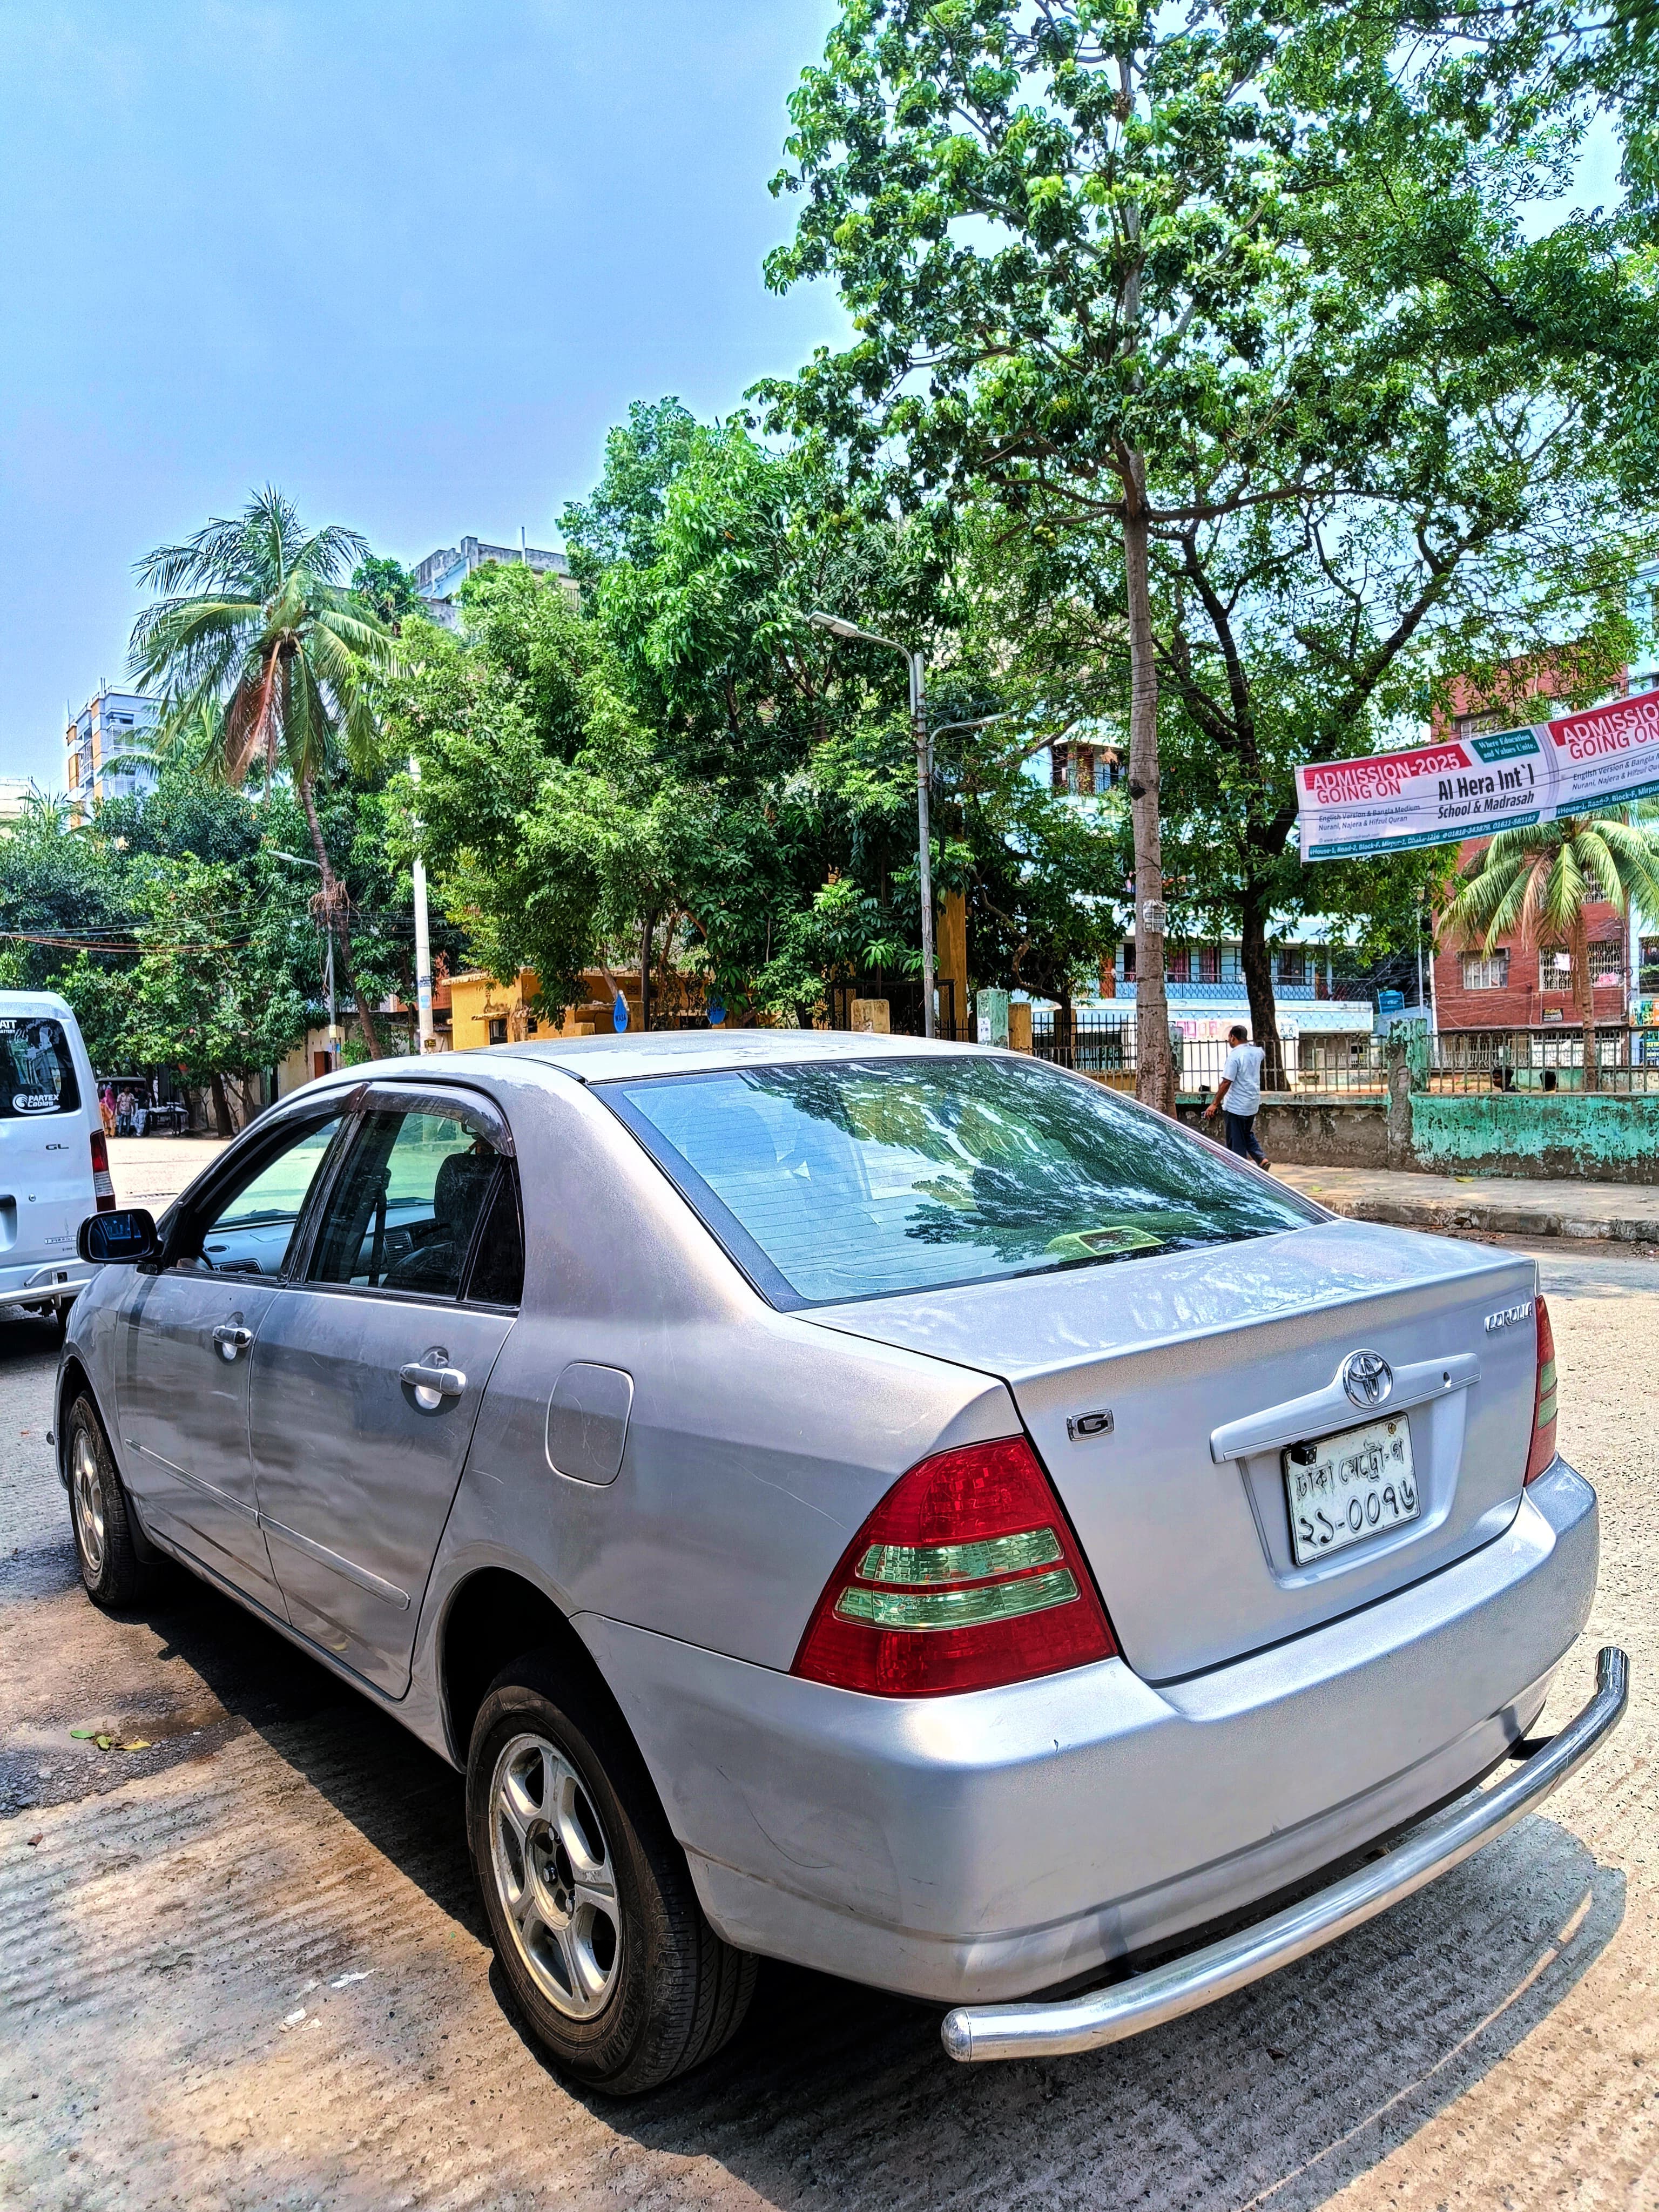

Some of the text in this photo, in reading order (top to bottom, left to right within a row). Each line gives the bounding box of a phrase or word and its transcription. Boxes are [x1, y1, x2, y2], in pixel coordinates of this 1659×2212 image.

[1563, 701, 1659, 744] ADMISSIO
[1479, 734, 1530, 749] Where Education
[1570, 721, 1659, 759] GOING ON
[1483, 750, 1495, 758] and
[1495, 747, 1516, 756] Values
[1313, 753, 1460, 790] ADMISSION-2025
[1574, 770, 1597, 781] English
[1599, 764, 1623, 774] Version
[1631, 755, 1654, 766] Bangla
[1456, 776, 1494, 798] Hera
[1598, 775, 1619, 785] Najera
[1317, 780, 1401, 804] GOING ON
[1319, 814, 1341, 822] English
[1373, 808, 1393, 816] Bangla
[1438, 791, 1534, 819] School & Madrasah
[1388, 816, 1407, 824] Quran
[1077, 1414, 1108, 1434] G
[1296, 1460, 1334, 1496] ঢাকা
